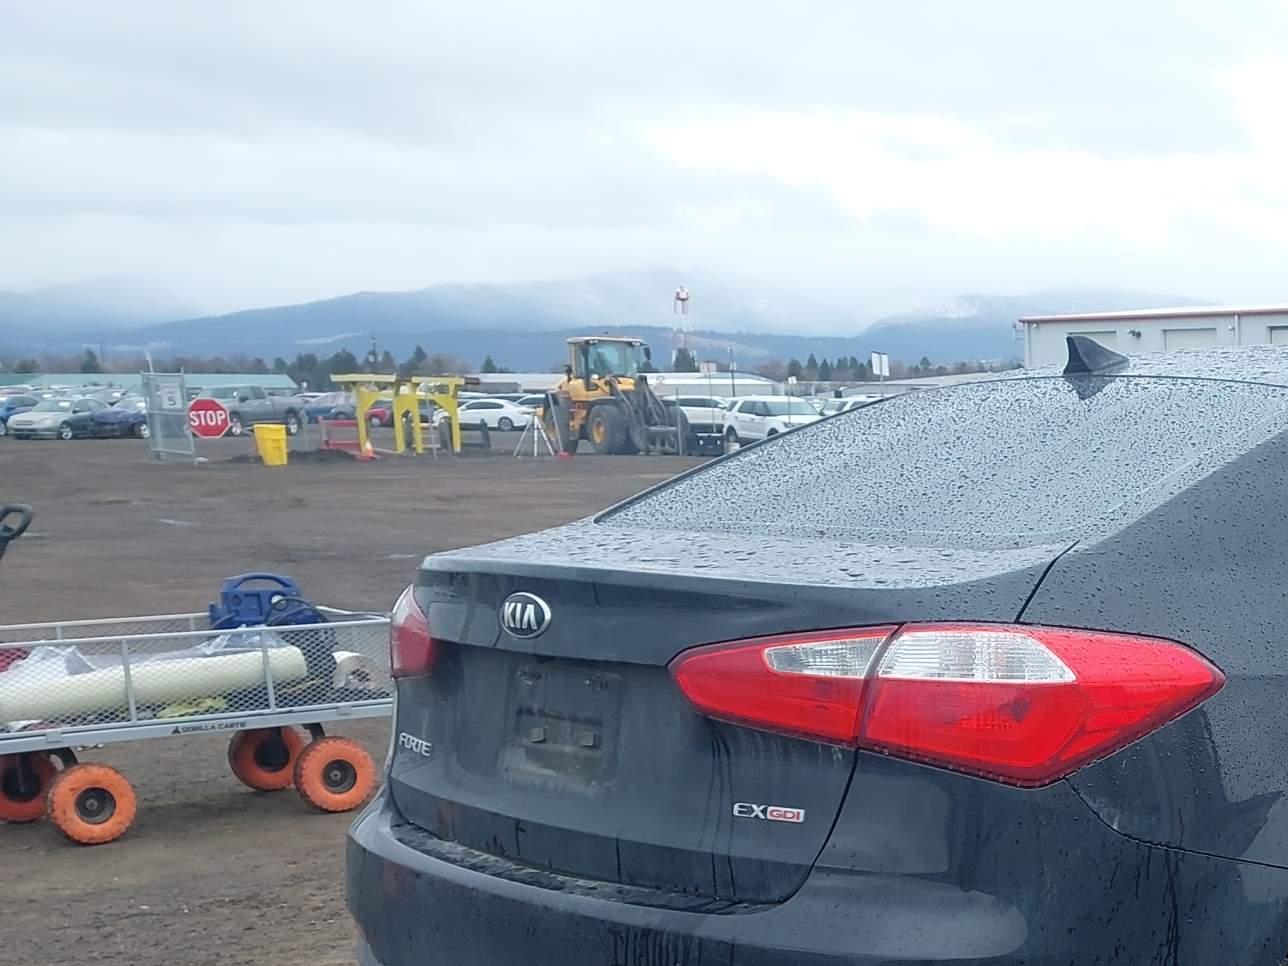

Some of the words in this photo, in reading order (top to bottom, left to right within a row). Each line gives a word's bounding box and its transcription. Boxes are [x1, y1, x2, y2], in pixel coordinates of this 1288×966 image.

[189, 410, 226, 426] STOP
[504, 602, 538, 630] KIA
[399, 732, 432, 757] FORTE
[733, 802, 768, 819] EX
[768, 808, 803, 822] GDI
